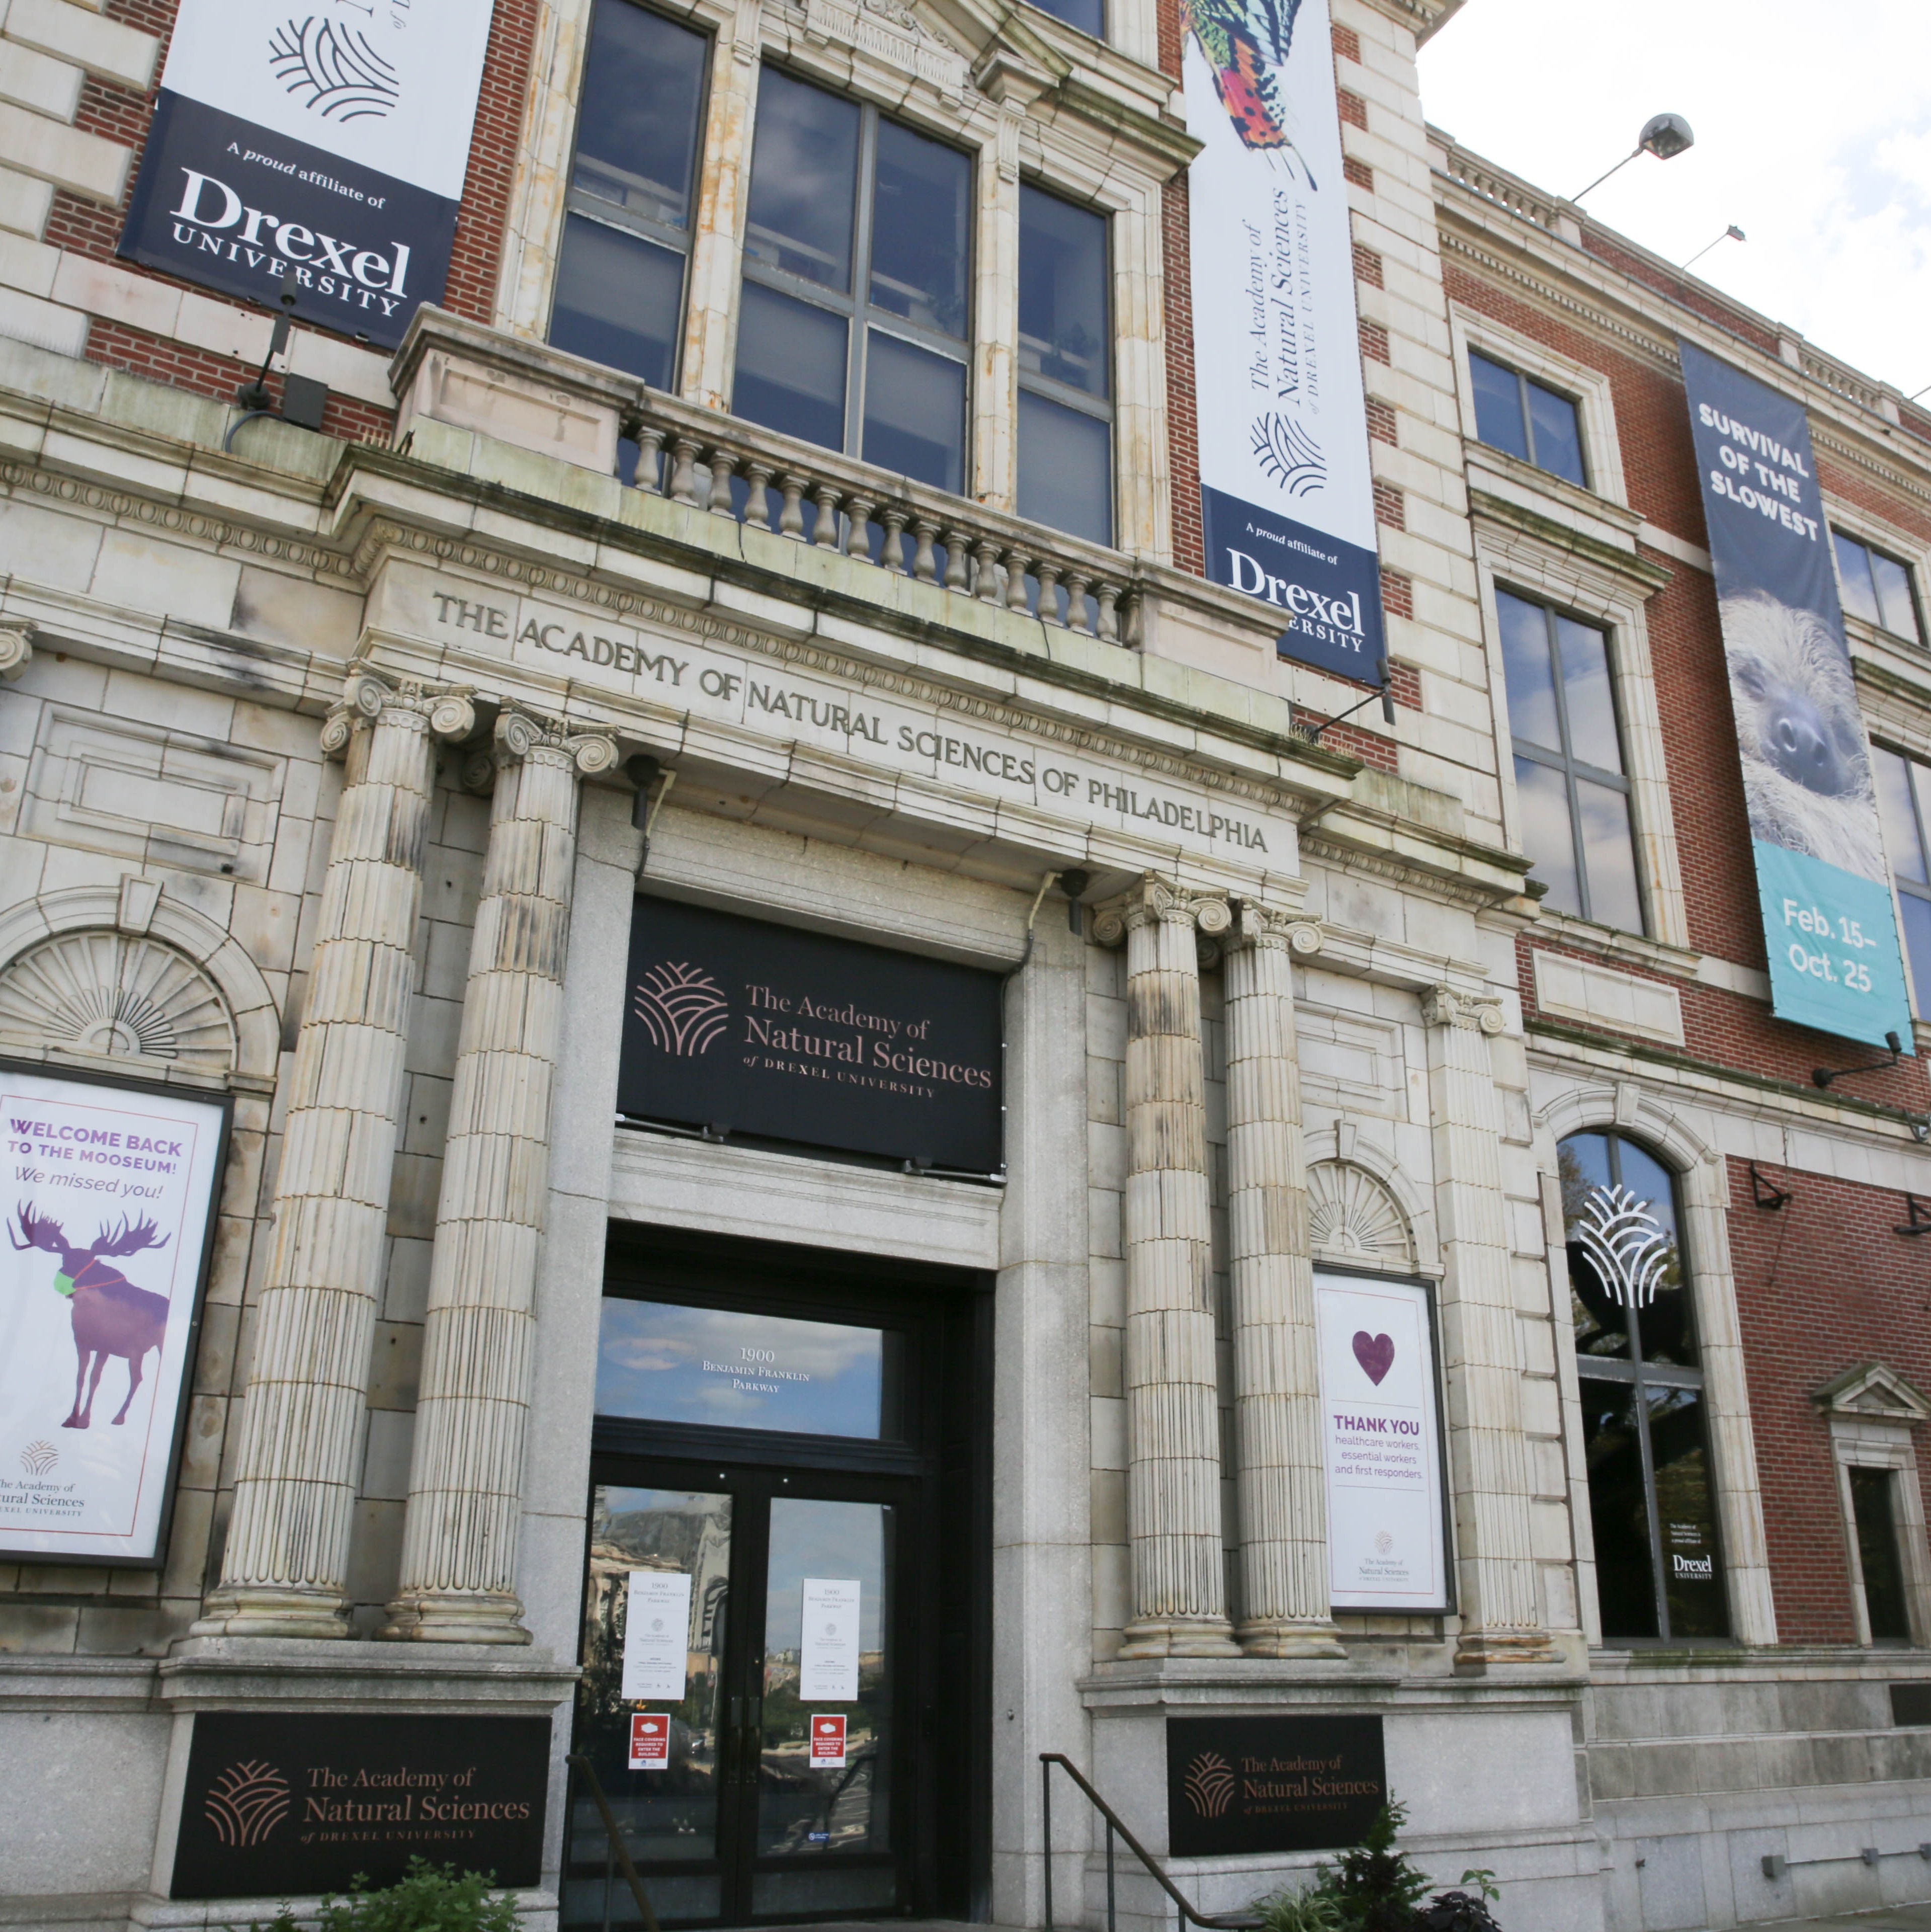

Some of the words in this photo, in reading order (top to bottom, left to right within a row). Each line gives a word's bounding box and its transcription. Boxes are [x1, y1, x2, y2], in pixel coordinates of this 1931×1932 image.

[226, 141, 240, 154] A
[243, 147, 295, 175] proud
[299, 166, 364, 201] affiliate
[368, 197, 386, 210] of
[170, 167, 410, 298] Drexel
[1242, 218, 1261, 246] of
[1269, 187, 1293, 296] Sciences
[173, 222, 401, 317] UNIVERSITY
[1296, 200, 1312, 312] UNIVERSITY
[1246, 253, 1267, 347] Academy
[1249, 351, 1269, 391] The
[1271, 298, 1300, 407] Natural
[1302, 321, 1318, 397] DREXEL
[1307, 403, 1320, 415] of
[1699, 403, 1809, 478] SURVIVAL
[1719, 445, 1748, 475] OF
[1754, 462, 1801, 503] THE
[1710, 470, 1818, 541] SLOWEST
[1246, 522, 1254, 533] A
[1256, 527, 1286, 545] proud
[1287, 539, 1325, 560] affiliate
[1327, 556, 1338, 565] of
[1226, 547, 1365, 636] Drexel
[1289, 615, 1363, 653] ERSITY
[433, 591, 509, 640] THE
[516, 618, 689, 686] ACADEMY
[699, 668, 742, 701] OF
[747, 681, 888, 745] NATURAL
[897, 725, 1035, 785] SCIENCES
[1042, 768, 1079, 797] OF
[1088, 779, 1269, 853] PHILADELPHIA
[1783, 898, 1836, 939] Feb.
[1789, 943, 1838, 983] Oct.
[1843, 959, 1872, 993] 25
[746, 985, 791, 1012] The
[796, 996, 901, 1038] Academy
[906, 1020, 930, 1040] of
[743, 1015, 863, 1064] Natural
[873, 1041, 991, 1088] Sciences
[743, 1056, 759, 1067] of
[765, 1058, 829, 1079] DREXEL
[837, 1072, 935, 1098] UNIVERSITY
[10, 1118, 121, 1148] WELCOME
[126, 1135, 183, 1157] BACK
[8, 1141, 32, 1154] TO
[38, 1144, 74, 1160] THE
[79, 1150, 177, 1174] MOOSEUM!
[15, 1166, 45, 1183] We
[49, 1173, 120, 1193] missed
[120, 1184, 163, 1199] you!
[740, 1347, 775, 1363] 1900
[1333, 1415, 1388, 1433] THANK
[1390, 1419, 1419, 1435] YOU
[1335, 1434, 1384, 1447] healthcare
[1334, 1465, 1353, 1474] and
[1355, 1465, 1372, 1476] first
[1341, 1452, 1382, 1462] essential
[1383, 1454, 1417, 1465] workers
[0, 1479, 13, 1488] he
[15, 1481, 61, 1493] Academy
[63, 1484, 76, 1492] of
[0, 1492, 29, 1504] ural
[31, 1493, 85, 1507] Sciences
[26, 1507, 82, 1516] UNIVERSITY
[1359, 1566, 1383, 1575] Natural
[1384, 1567, 1409, 1575] Sciences
[1672, 1555, 1712, 1572] Drexel
[307, 1767, 348, 1788] The
[353, 1768, 449, 1792] Academy
[453, 1767, 477, 1787] of
[1241, 1756, 1267, 1773] The
[1270, 1755, 1327, 1774] Academy
[1329, 1754, 1342, 1770] of
[1243, 1776, 1308, 1799] Natural
[1312, 1776, 1379, 1796] Sciences
[302, 1795, 411, 1822] Natural
[419, 1795, 531, 1821] Sciences
[300, 1832, 316, 1843] of
[320, 1831, 379, 1841] DREXEL
[386, 1829, 477, 1841] UNIVERSITY
